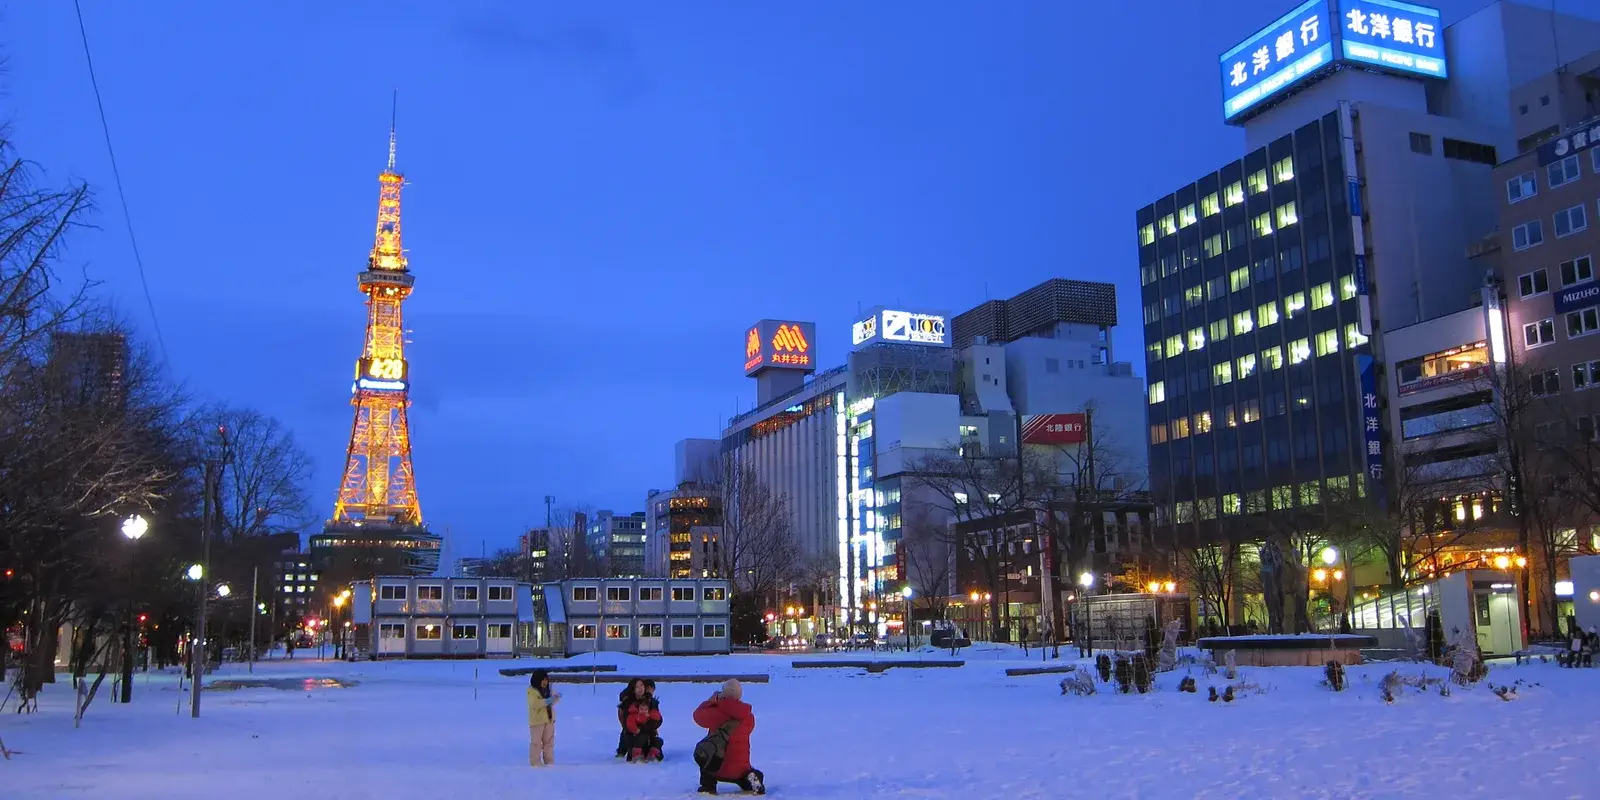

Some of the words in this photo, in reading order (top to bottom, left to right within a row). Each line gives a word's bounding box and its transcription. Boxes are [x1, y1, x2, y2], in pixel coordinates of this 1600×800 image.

[1346, 8, 1435, 48] 北洋銀行
[1230, 15, 1319, 87] 北洋銀行
[1562, 286, 1599, 304] MIZUHO
[772, 354, 809, 365] 丸井今井
[1364, 393, 1383, 479] 北洋銀行
